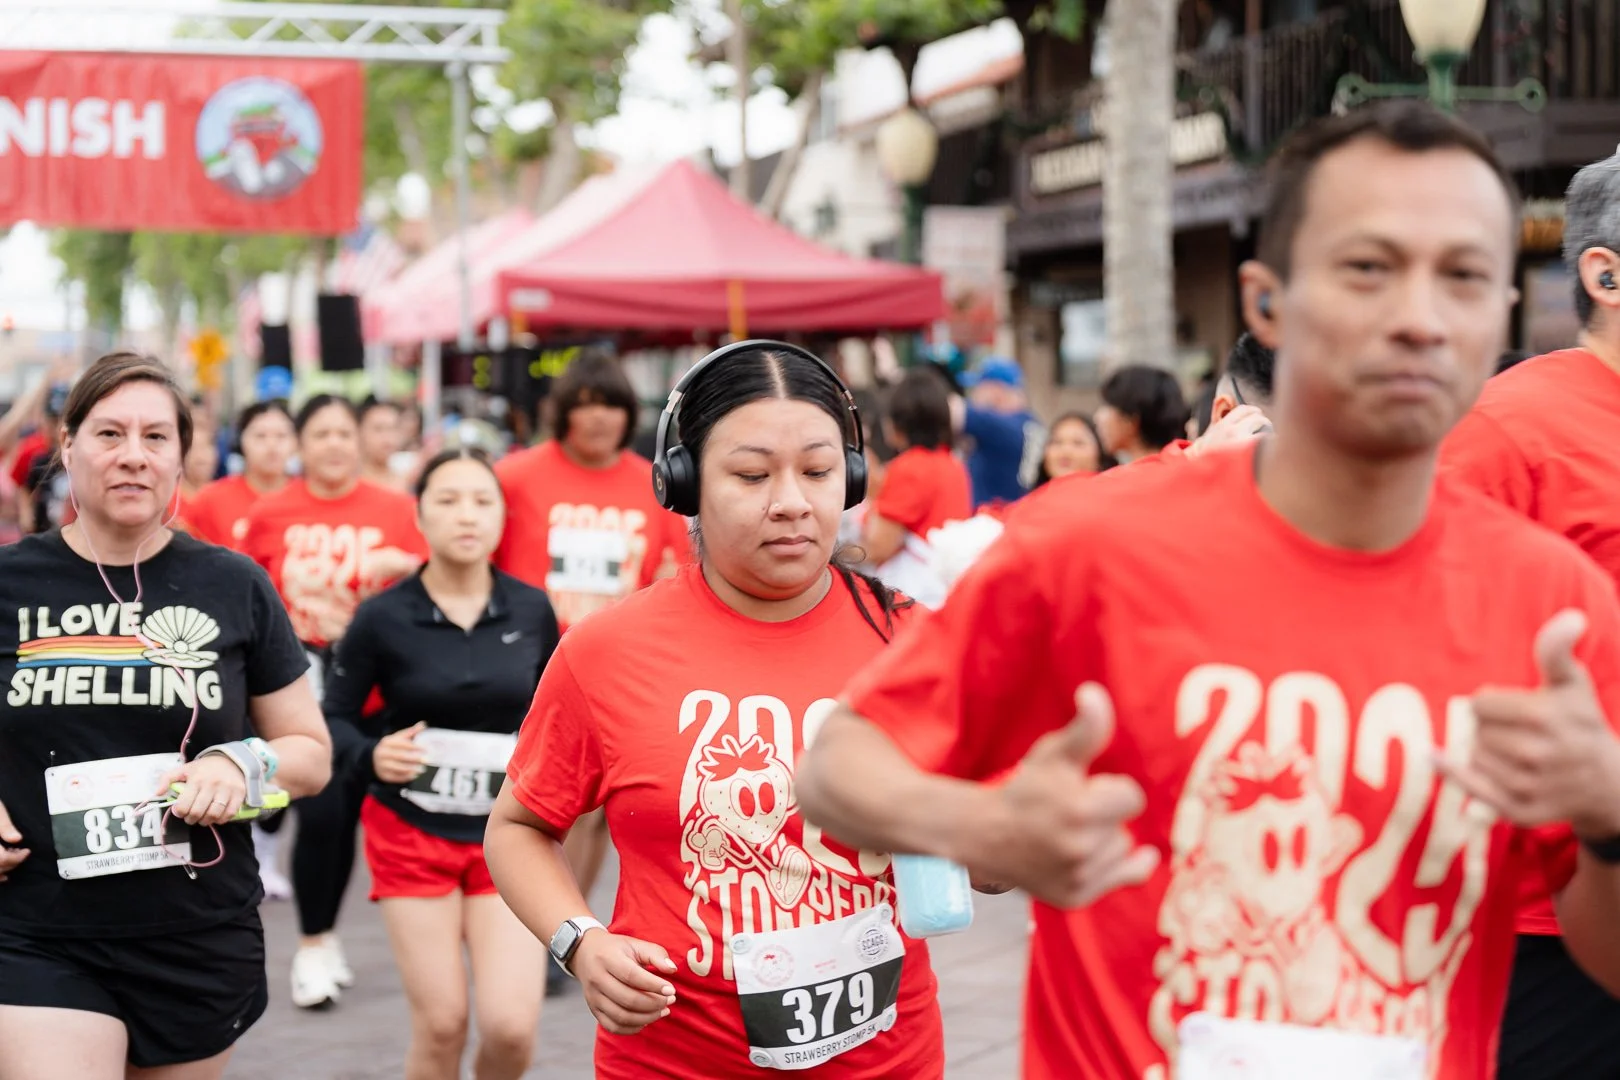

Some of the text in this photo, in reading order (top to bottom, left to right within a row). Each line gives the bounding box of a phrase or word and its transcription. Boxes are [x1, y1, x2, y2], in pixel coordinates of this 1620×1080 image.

[0, 96, 165, 160] NISH
[18, 602, 144, 642] I LOVE
[7, 666, 223, 710] SHELLING
[431, 767, 491, 799] 461
[84, 802, 162, 854] 834
[86, 856, 135, 870] STRAWBERRY
[138, 852, 159, 863] STOMP
[782, 972, 874, 1044] 379
[785, 1023, 877, 1064] STRAWBERRY STOMP 5K
